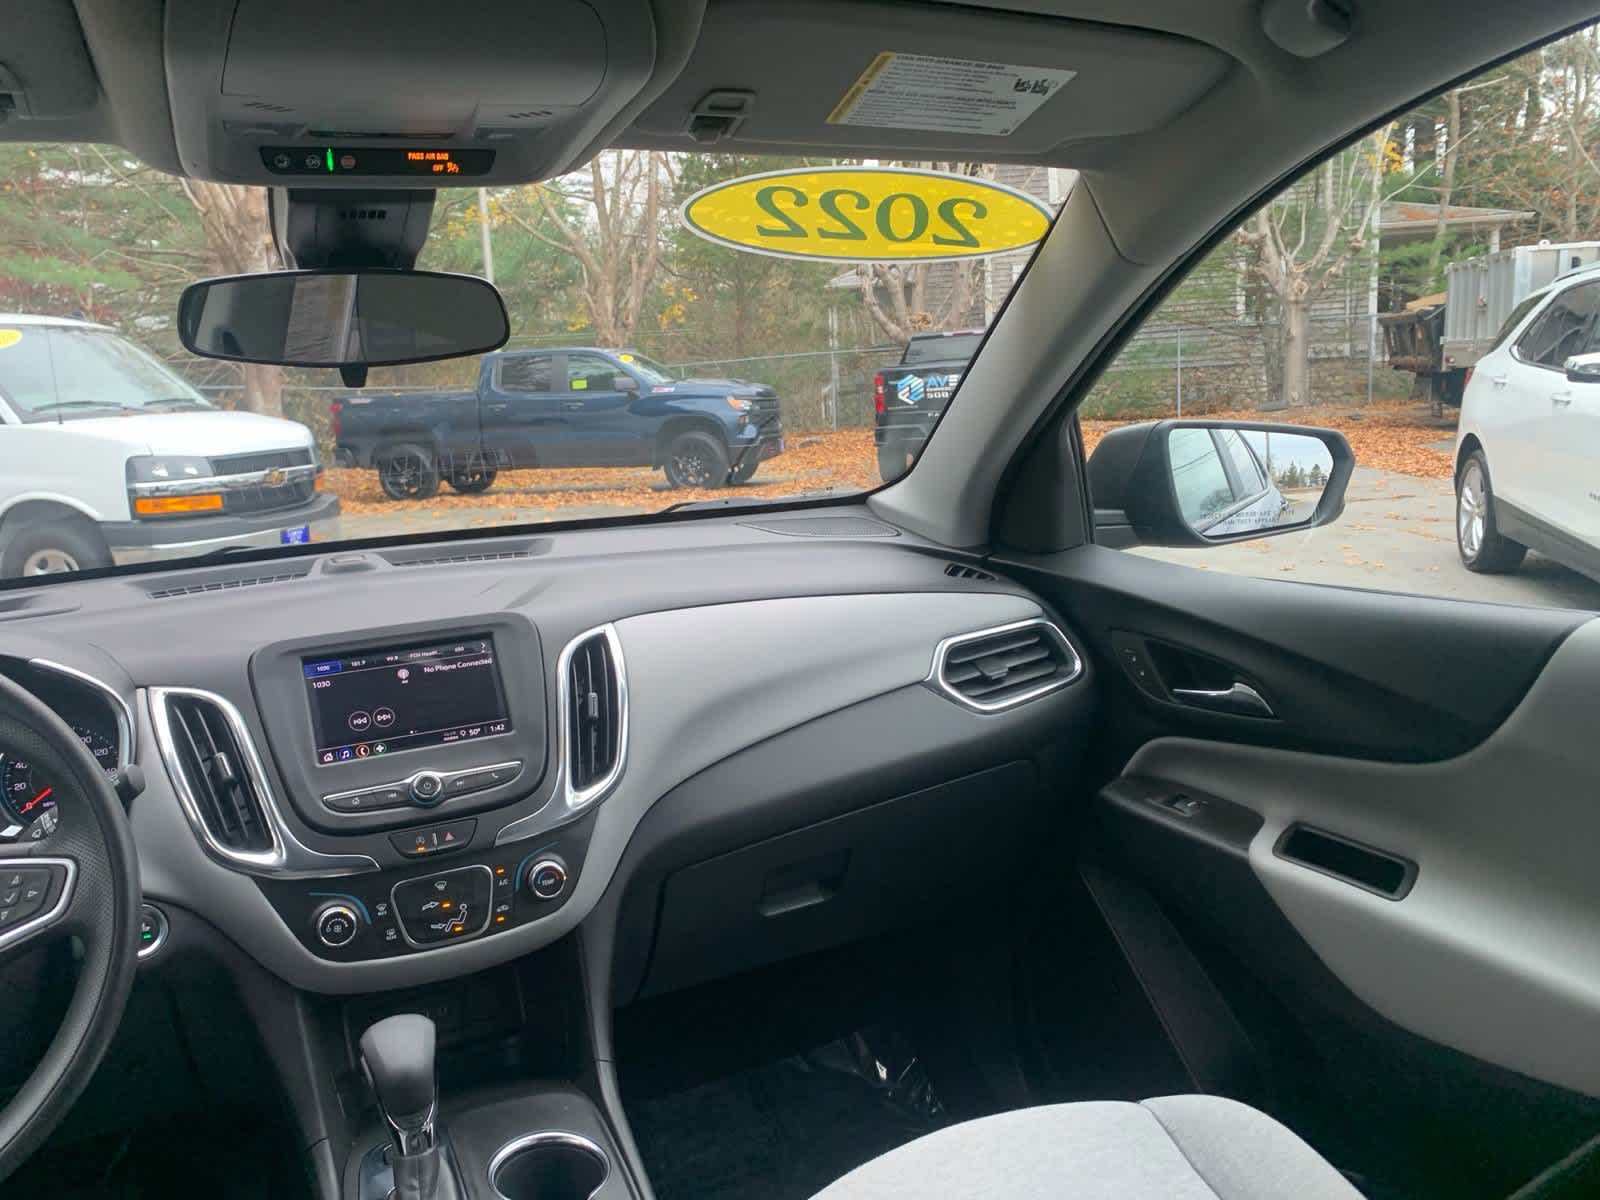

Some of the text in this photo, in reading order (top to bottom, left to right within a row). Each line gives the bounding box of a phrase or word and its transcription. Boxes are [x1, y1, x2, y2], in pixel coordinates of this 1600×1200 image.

[408, 152, 449, 160] PASS AIR BAG
[432, 164, 444, 172] OFF
[435, 663, 457, 672] Phone
[457, 657, 492, 669] Connected
[313, 680, 331, 689] 1030
[490, 724, 505, 732] 1:42
[14, 782, 26, 791] 20
